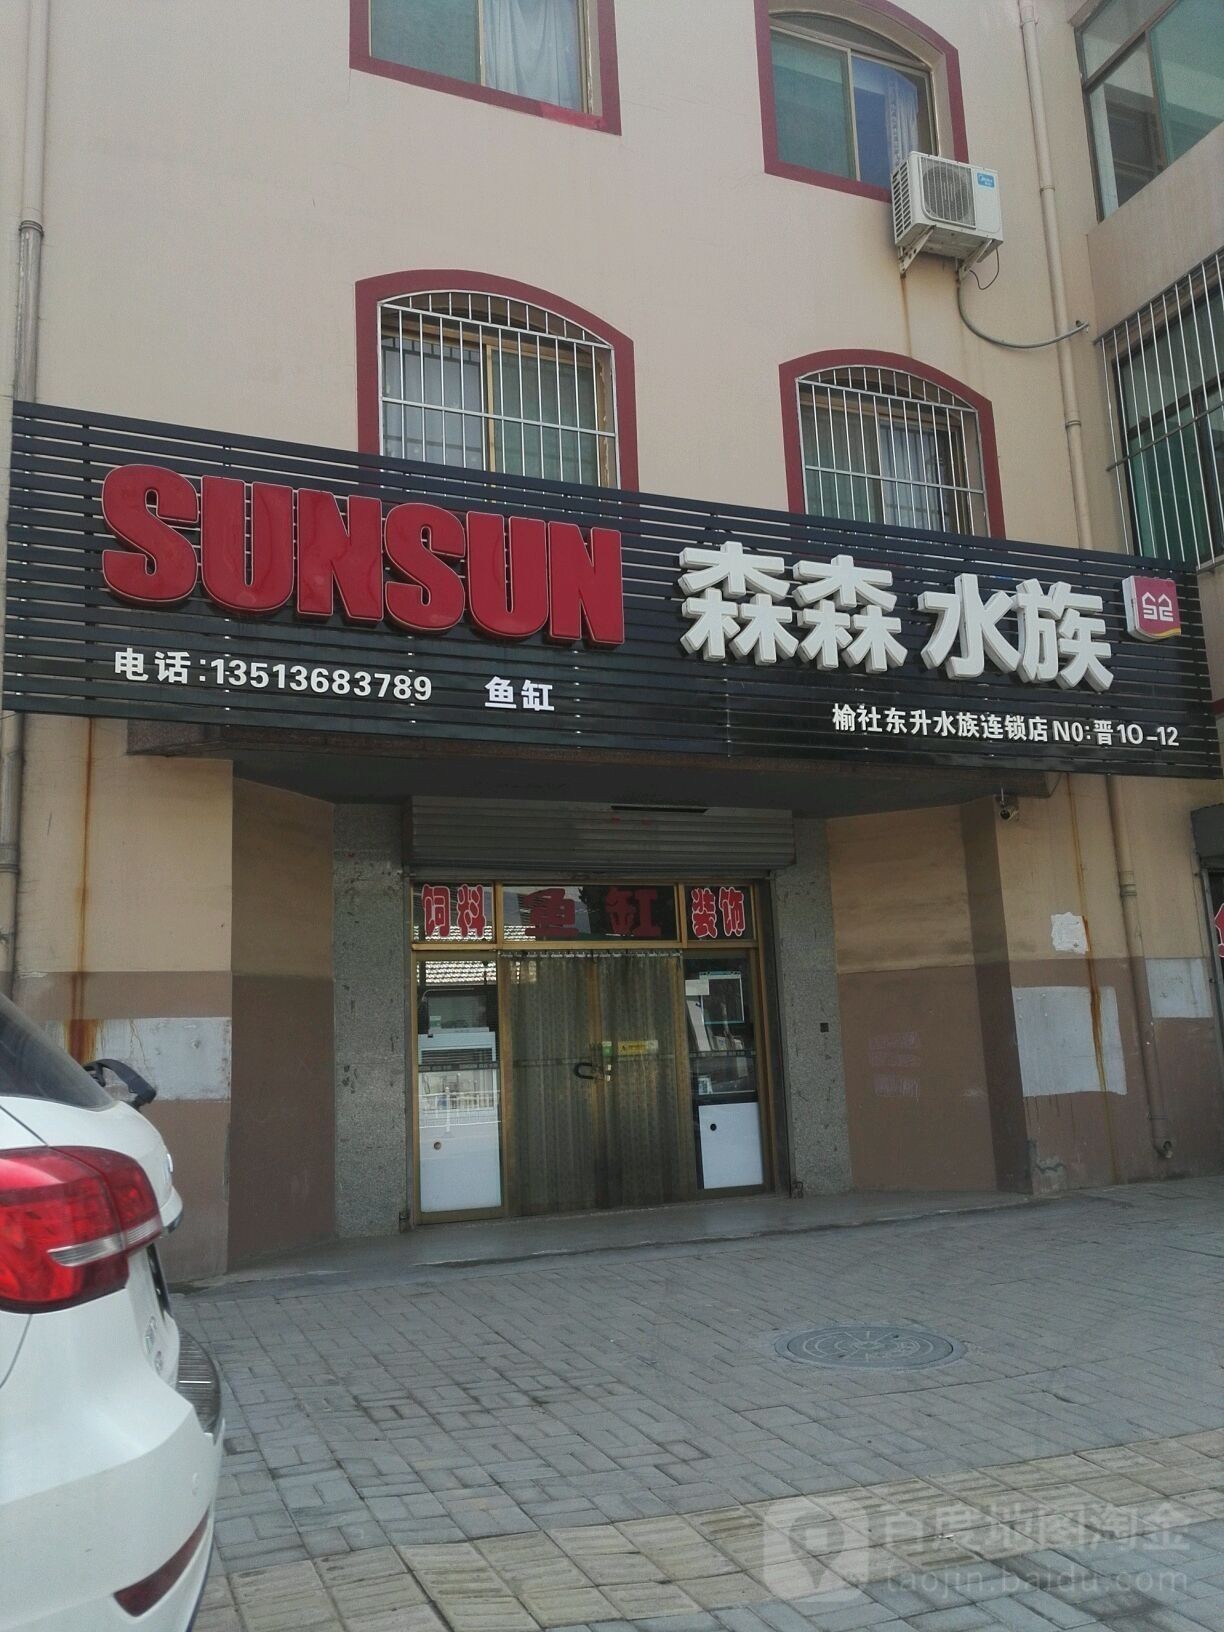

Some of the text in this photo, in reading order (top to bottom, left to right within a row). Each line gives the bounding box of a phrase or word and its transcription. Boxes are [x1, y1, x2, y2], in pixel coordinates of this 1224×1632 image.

[101, 463, 625, 648] SUNSUN
[678, 541, 1115, 692] 森森水族
[484, 676, 555, 712] 鱼缸
[421, 884, 745, 938] 饲料 鱼缸 装饰
